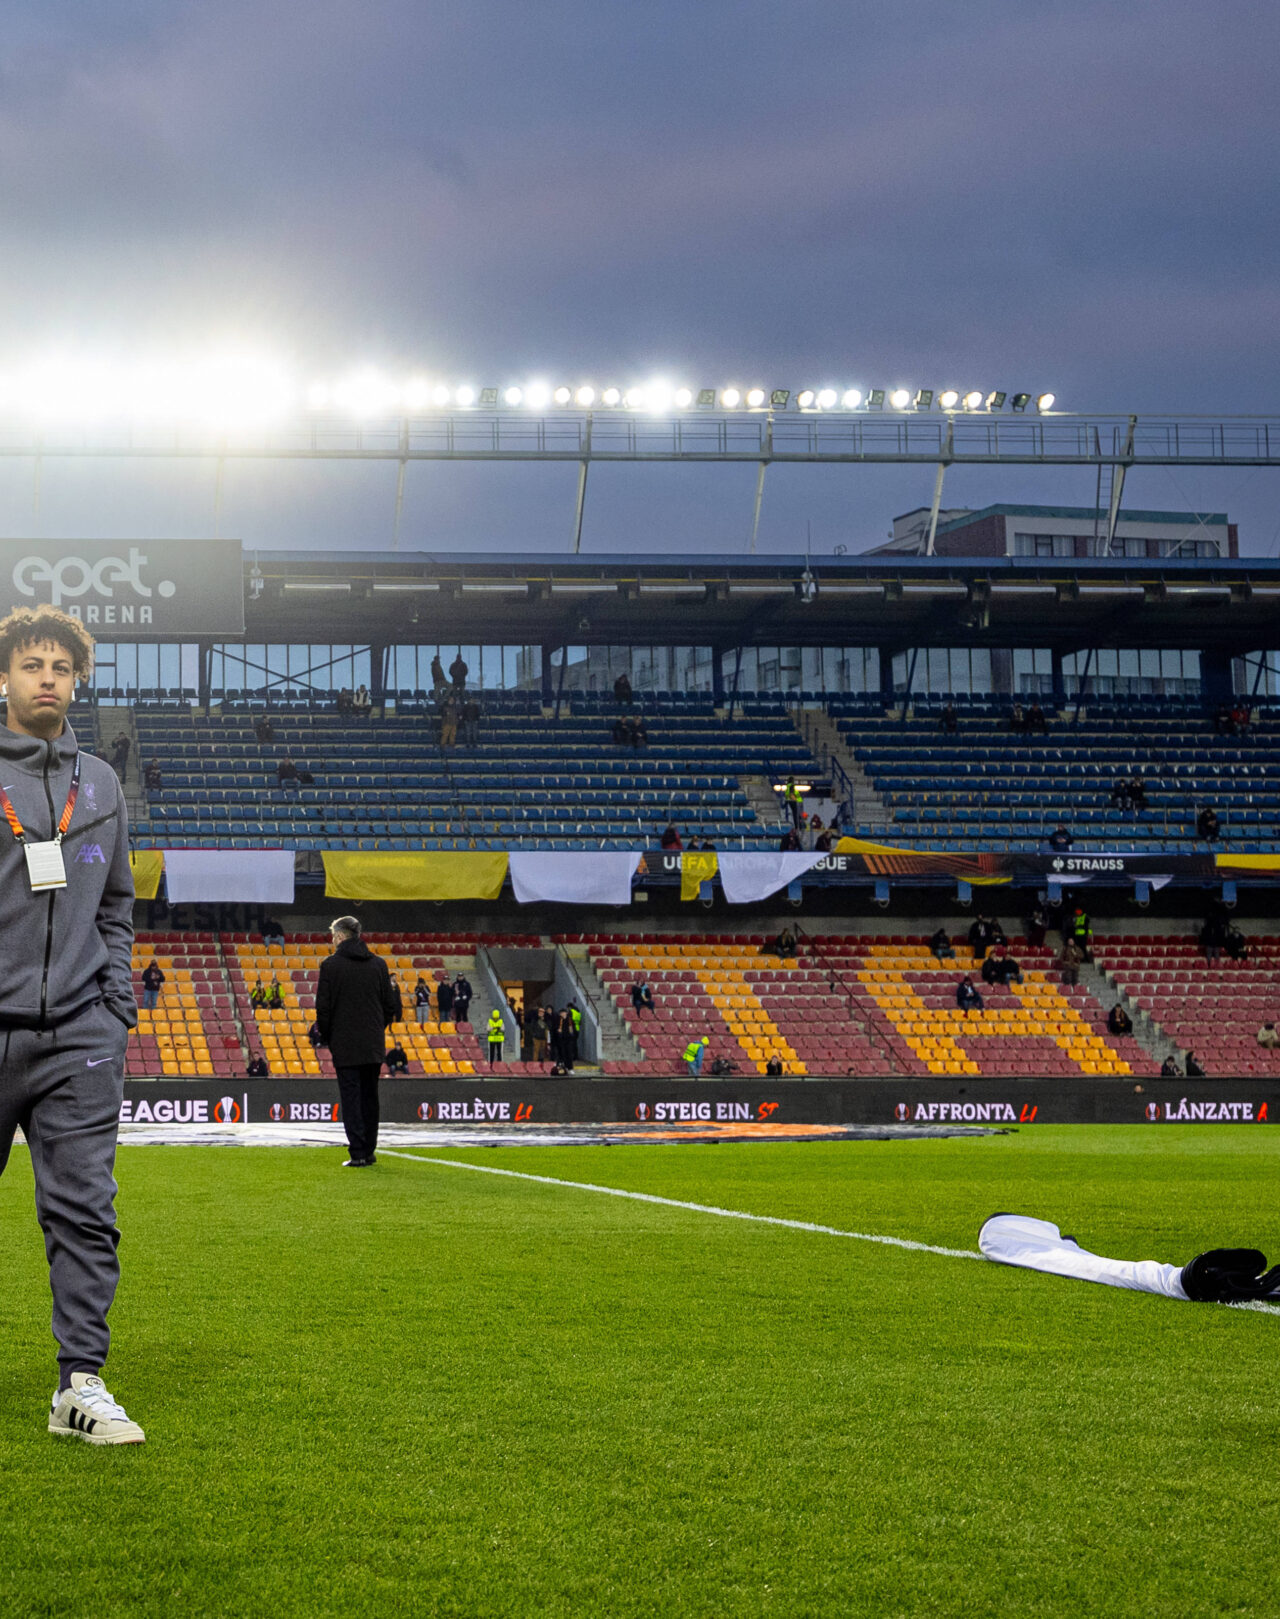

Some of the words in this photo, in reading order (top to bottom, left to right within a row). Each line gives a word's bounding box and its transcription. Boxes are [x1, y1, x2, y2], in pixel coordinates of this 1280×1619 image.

[69, 605, 153, 624] ARENA
[74, 843, 106, 864] AXA
[663, 856, 708, 870] UEFA
[1066, 859, 1125, 871] STRAUSS
[118, 1100, 209, 1123] EAGUE
[289, 1103, 332, 1120] RISE
[437, 1097, 510, 1120] RELÈVE
[654, 1102, 711, 1120] STEIG
[716, 1103, 754, 1120] EIN.
[914, 1103, 1017, 1120] AFFRONTA
[1165, 1097, 1254, 1120] LÁNZATE
